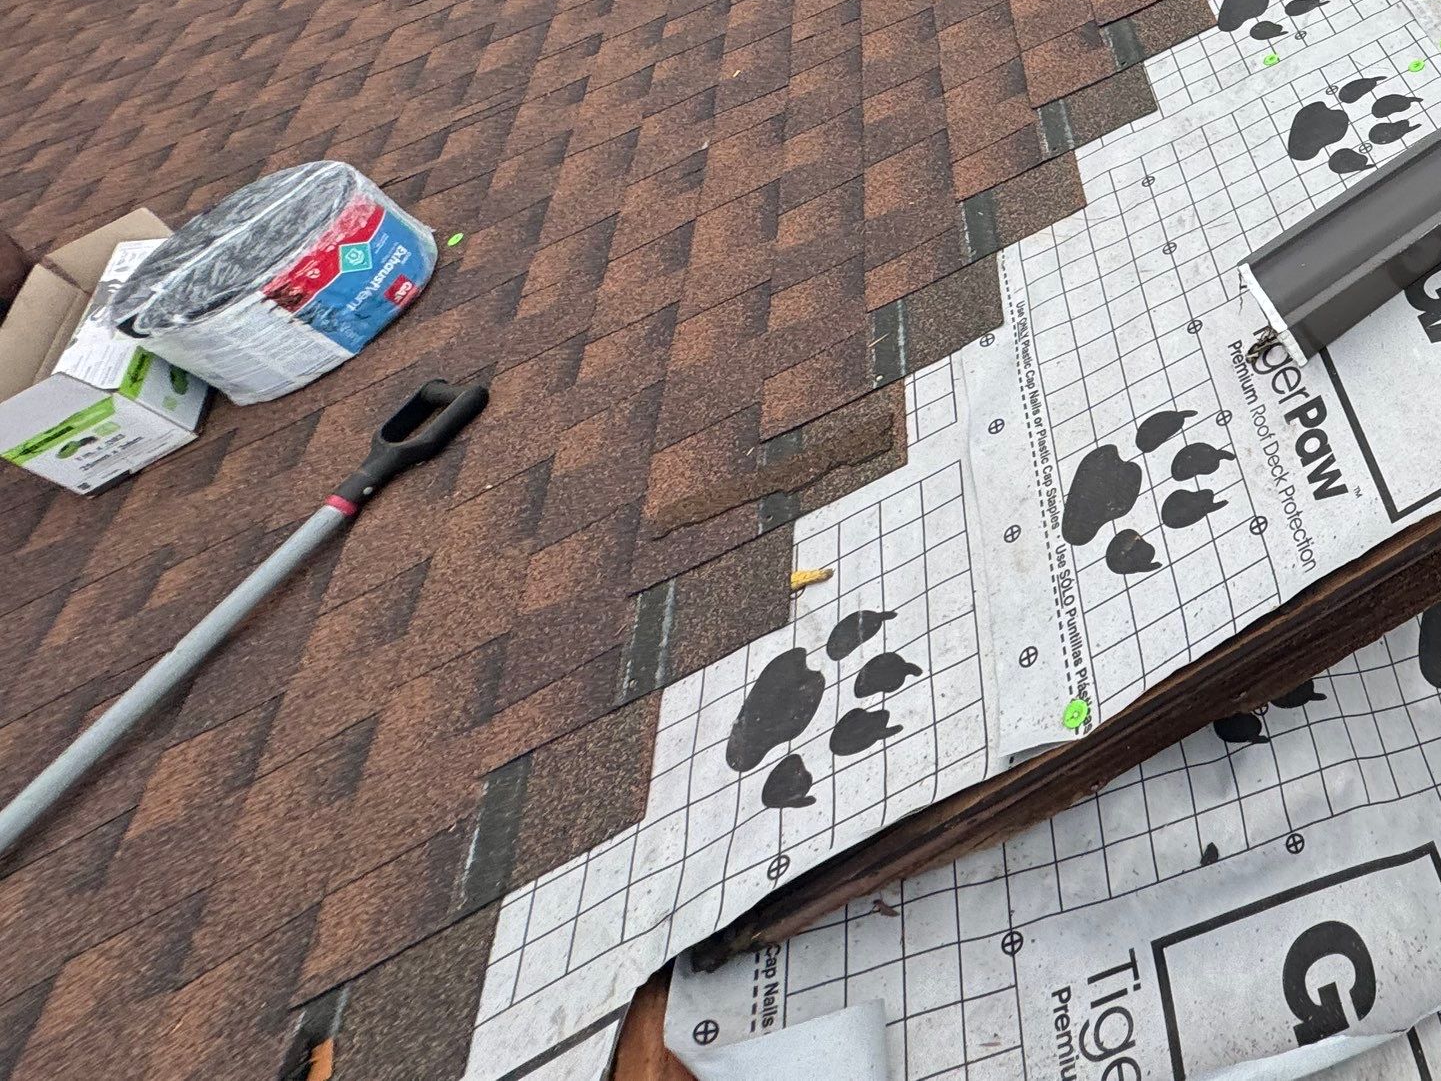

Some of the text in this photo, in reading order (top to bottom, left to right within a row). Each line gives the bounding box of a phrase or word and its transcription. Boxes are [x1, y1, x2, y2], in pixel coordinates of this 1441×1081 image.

[346, 244, 409, 312] ExhaustVent
[1015, 299, 1026, 318] Use
[1017, 317, 1029, 341] ONLY
[1021, 339, 1033, 370] Plastic
[1025, 369, 1036, 390] Cap
[1029, 389, 1042, 416] Nails
[1247, 325, 1349, 501] gerPaw
[1033, 418, 1043, 428] or
[1036, 428, 1051, 465] Plastic
[1227, 339, 1317, 574] Premium Roof Deck Protection
[1042, 465, 1053, 487] Cap
[1046, 487, 1060, 530] Staples
[1055, 543, 1067, 569] Use
[1065, 607, 1084, 668] Puntillas
[760, 942, 782, 1029] Cap Nails
[1079, 947, 1142, 1081] Tige
[1051, 985, 1079, 1081] Premiu
